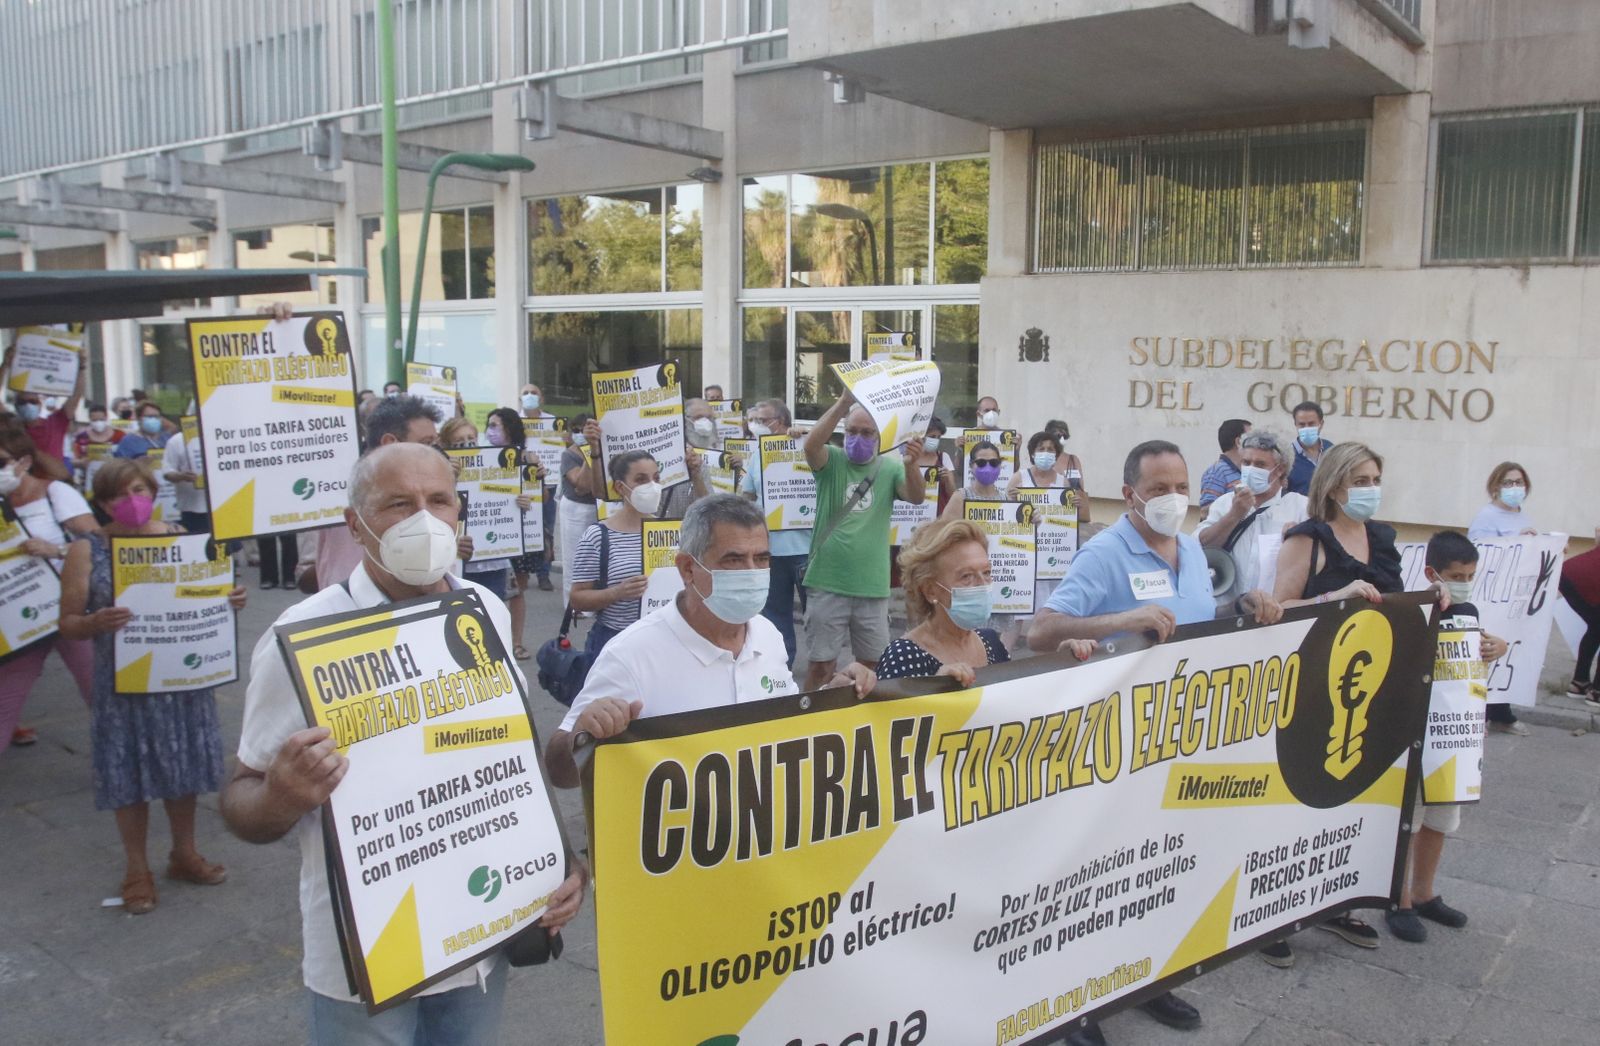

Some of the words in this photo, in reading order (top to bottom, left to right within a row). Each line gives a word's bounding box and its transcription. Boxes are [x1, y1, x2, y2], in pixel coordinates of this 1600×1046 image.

[200, 332, 259, 358] CONTRA
[262, 332, 276, 354] EL
[1128, 336, 1499, 374] SUBDELEGACION
[203, 358, 271, 387] TARIFAZO
[273, 352, 348, 381] ELÉCTRICO
[596, 378, 632, 395] CONTRA
[633, 376, 642, 390] EL
[871, 391, 900, 405] PRECIOS
[902, 388, 912, 397] DE
[913, 385, 925, 394] LUZ
[1128, 379, 1204, 411] DEL
[1247, 381, 1494, 422] GOBIERNO
[215, 428, 235, 440] Por
[240, 427, 261, 438] una
[264, 420, 305, 436] TARIFA
[308, 416, 347, 431] SOCIAL
[635, 428, 658, 439] TARIFA
[659, 420, 678, 433] SOCIAL
[217, 444, 245, 458] para
[250, 440, 267, 452] los
[270, 432, 348, 451] consumidores
[608, 444, 625, 452] para
[627, 441, 637, 449] los
[648, 441, 673, 454] recursos
[764, 441, 789, 451] CONTRA
[790, 440, 796, 450] EL
[218, 460, 240, 471] con
[244, 456, 283, 469] menos
[287, 448, 334, 464] recursos
[476, 455, 484, 467] EL
[664, 456, 683, 468] facua
[318, 480, 347, 492] facu
[474, 501, 482, 509] de
[1020, 494, 1042, 503] CONTRA
[1044, 494, 1050, 503] EL
[480, 509, 488, 517] DE
[968, 509, 996, 520] CONTRA
[997, 509, 1004, 520] EL
[648, 530, 680, 548] CONTRA
[119, 547, 167, 564] CONTRA
[171, 545, 182, 562] EL
[165, 611, 198, 622] TARIFA
[201, 604, 228, 618] SOCIAL
[648, 598, 659, 608] Por
[124, 626, 147, 634] para
[151, 624, 165, 633] los
[168, 616, 228, 633] consumidores
[145, 635, 177, 644] menos
[180, 630, 218, 642] recursos
[204, 650, 231, 663] facua
[1461, 641, 1471, 658] EL
[313, 648, 400, 705] CONTRA
[395, 643, 422, 680] EL
[325, 685, 420, 750] TARIFAZO
[420, 660, 513, 720] ELÉCTRICO
[1429, 711, 1461, 722] ¡Basta
[1464, 711, 1473, 720] de
[435, 723, 509, 748] ¡Movilízate!
[1430, 724, 1470, 736] PRECIOS
[640, 723, 881, 876] CONTRA
[890, 714, 935, 823] EL
[936, 691, 1121, 832] TARIFAZO
[1129, 658, 1301, 775] ELÉCTRICO
[351, 812, 378, 836] Por
[384, 799, 415, 822] una
[418, 774, 472, 810] TARIFA
[474, 755, 526, 789] SOCIAL
[1177, 774, 1269, 801] ¡Movilízate!
[356, 834, 395, 865] para
[399, 822, 423, 843] los
[427, 781, 533, 832] consumidores
[362, 861, 391, 886] con
[395, 838, 447, 872] menos
[450, 811, 519, 849] recursos
[1245, 845, 1288, 874] ¡Basta
[1293, 836, 1308, 857] de
[1312, 817, 1363, 850] abusos!
[504, 852, 557, 884] facua
[1000, 893, 1030, 918] Por
[1033, 883, 1050, 905] la
[1053, 846, 1135, 901] prohibición
[1140, 838, 1158, 860] de
[1163, 832, 1184, 854] los
[1250, 860, 1305, 899] PRECIOS
[1308, 854, 1325, 877] DE
[1328, 844, 1352, 870] LUZ
[767, 892, 841, 941] ¡STOP
[850, 881, 875, 915] al
[973, 911, 1039, 952] CORTES
[1041, 900, 1062, 927] DE
[1064, 886, 1092, 916] LUZ
[1095, 875, 1130, 908] para
[1136, 854, 1197, 890] aquellos
[1234, 889, 1306, 932] razonables
[1310, 885, 1318, 906] y
[1320, 870, 1359, 902] justos
[998, 944, 1027, 974] que
[1033, 933, 1052, 956] no
[1057, 909, 1114, 951] pueden
[1119, 885, 1176, 927] pagarla
[660, 933, 834, 1001] OLIGOPOLIO
[843, 892, 956, 956] eléctrico!
[996, 956, 1152, 1046] FACUA.org/tarifazo
